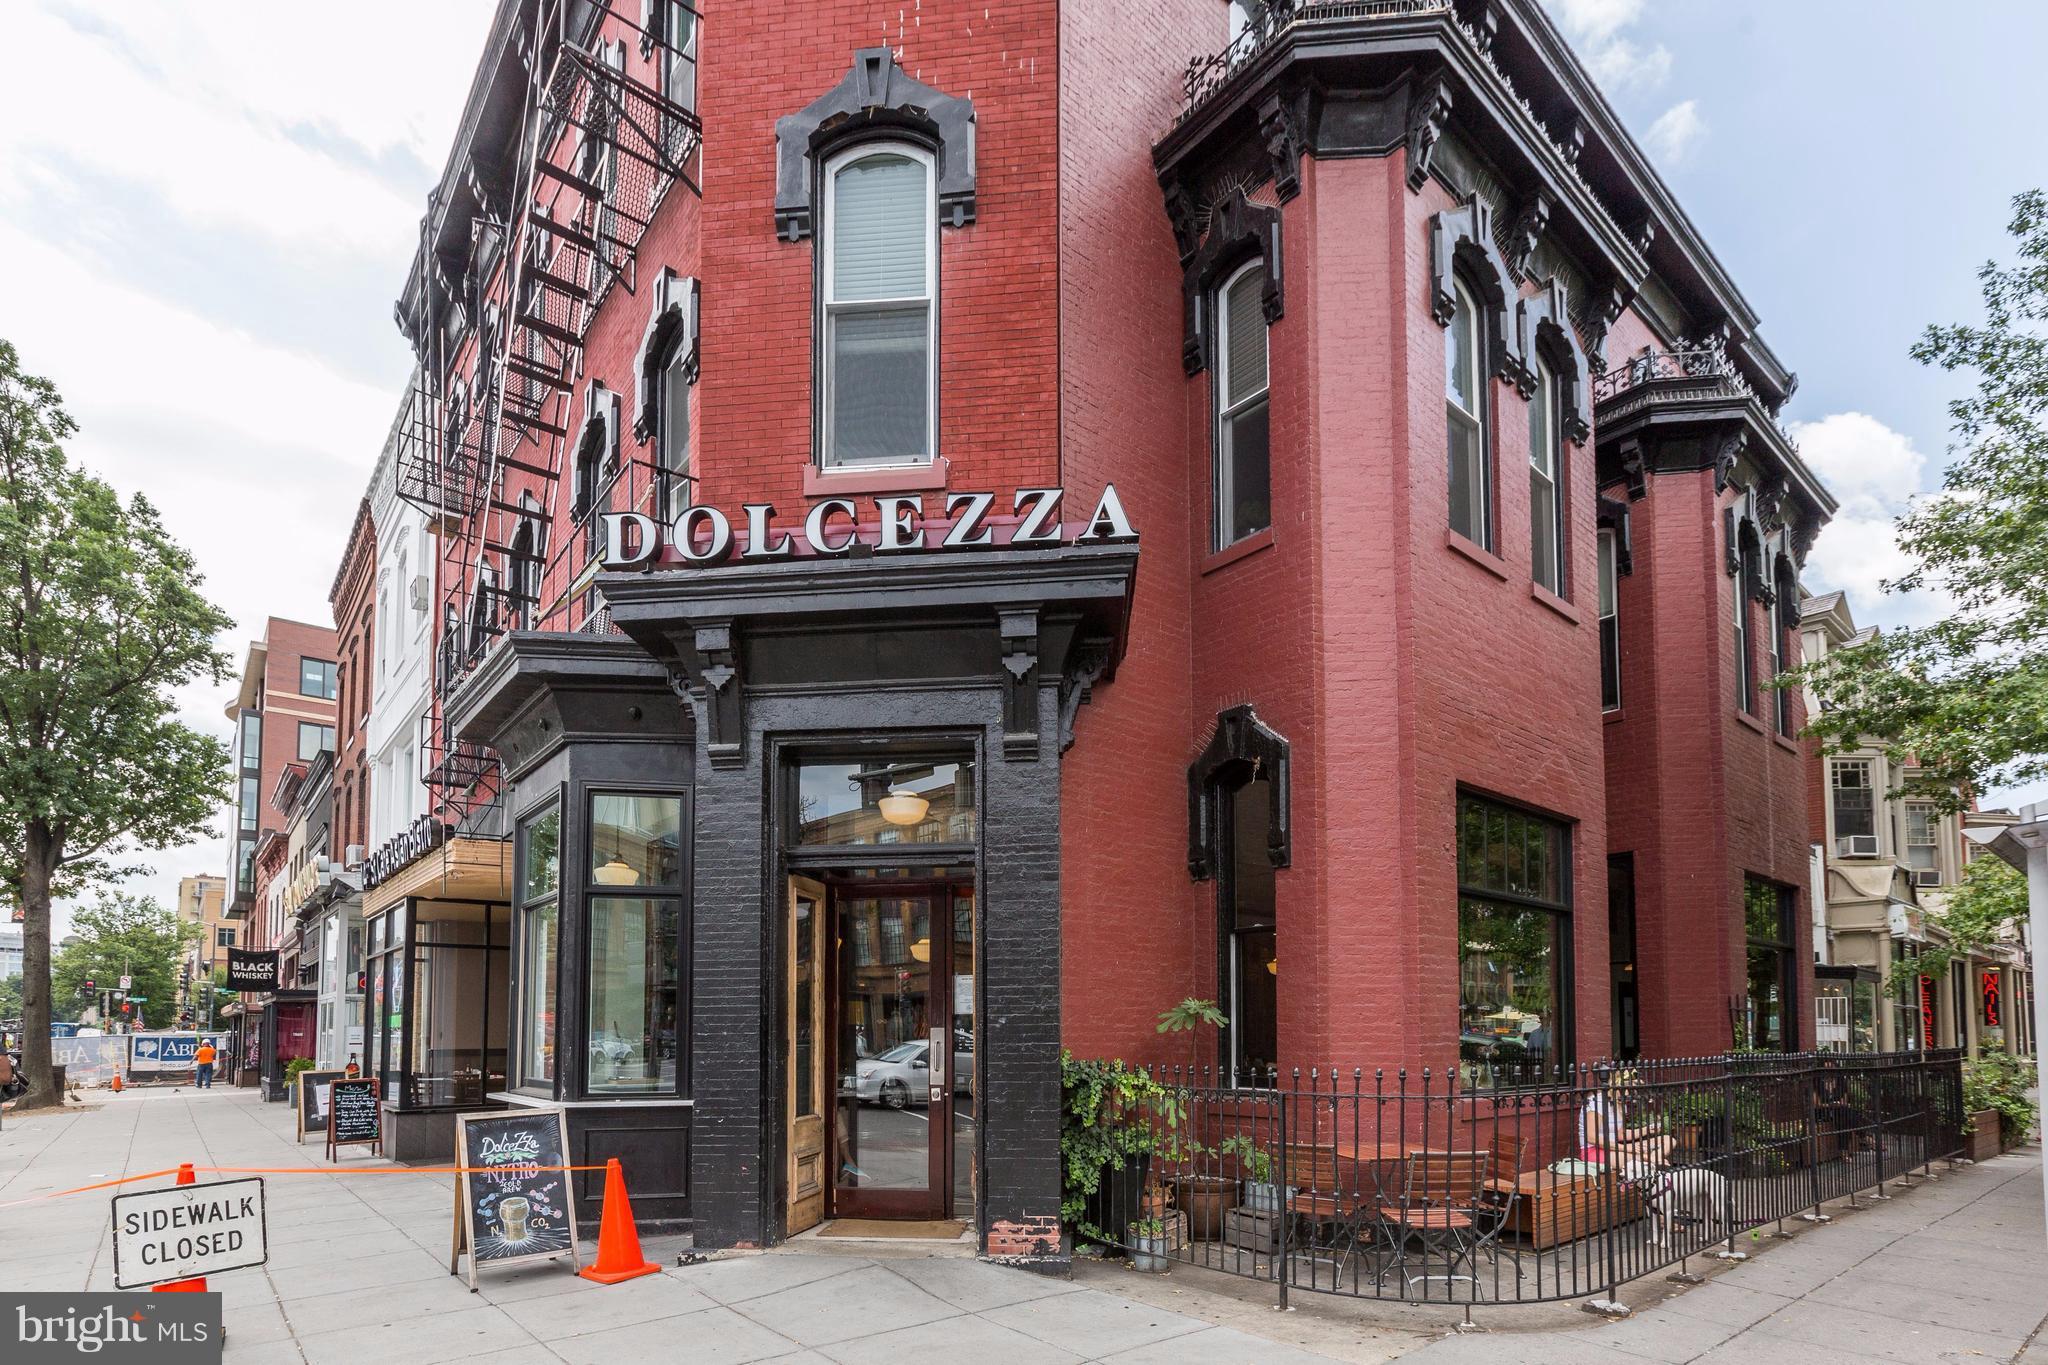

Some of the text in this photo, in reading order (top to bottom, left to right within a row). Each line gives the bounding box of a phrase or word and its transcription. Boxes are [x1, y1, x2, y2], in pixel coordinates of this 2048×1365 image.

[600, 482, 1140, 569] DOLCEZZA
[232, 961, 274, 972] BLACK
[232, 971, 274, 980] WHISKEY
[1983, 973, 1999, 1026] NAILS
[162, 1040, 199, 1056] ABD
[487, 1161, 539, 1183] NITRO
[502, 1186, 521, 1194] BREW
[125, 1197, 255, 1235] SIDEWALK
[141, 1230, 243, 1266] CLOSED
